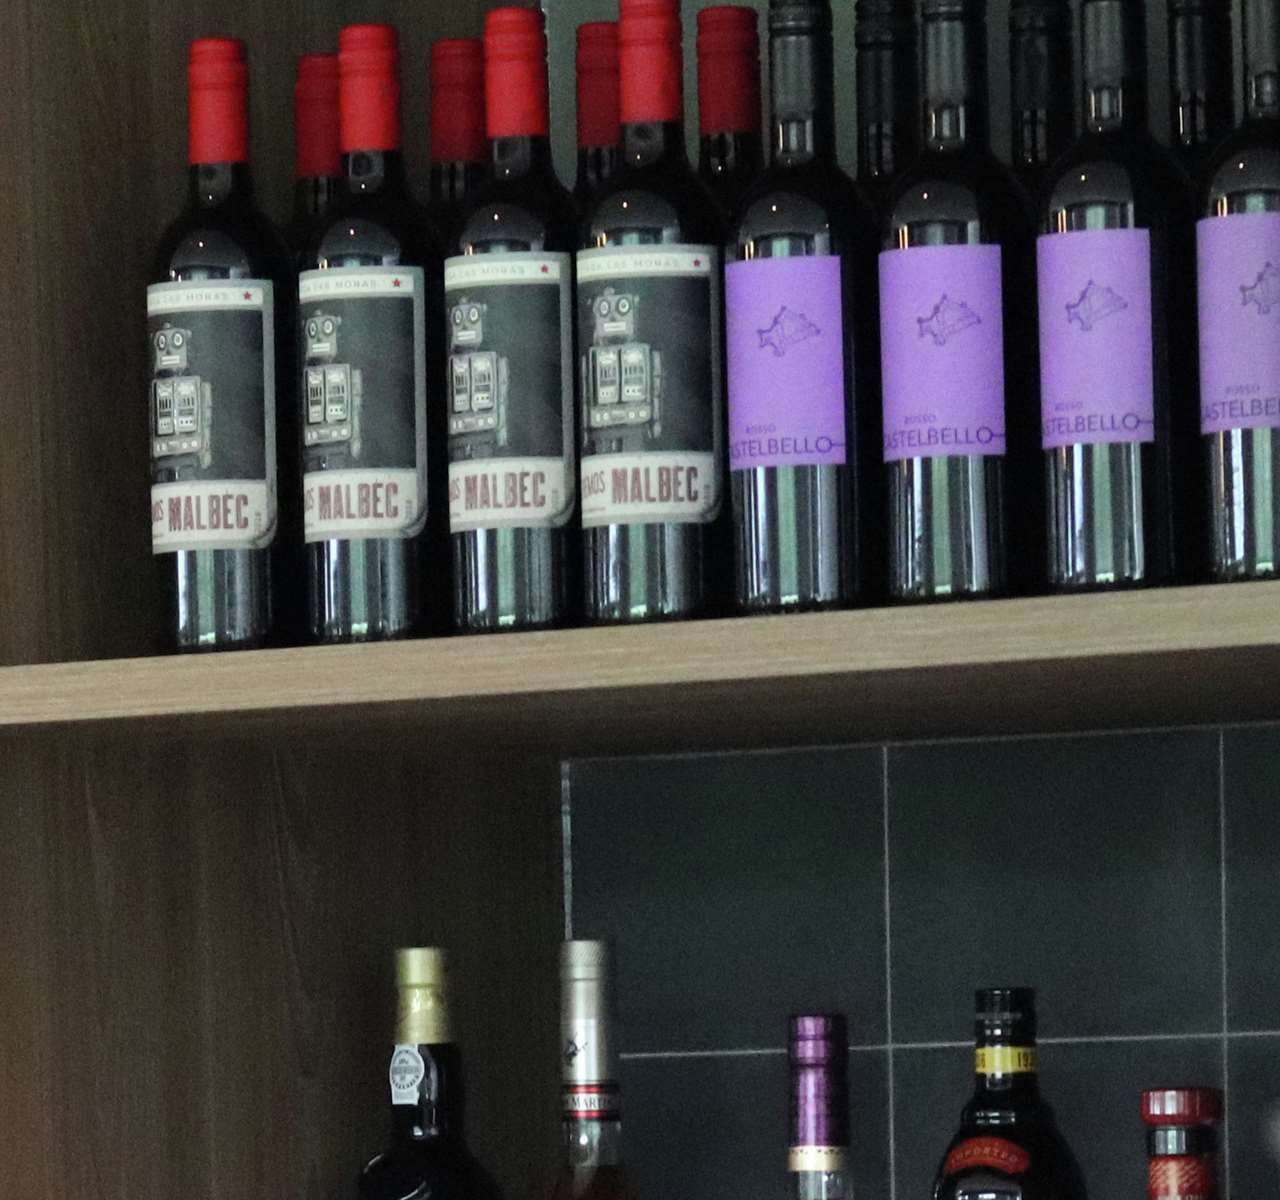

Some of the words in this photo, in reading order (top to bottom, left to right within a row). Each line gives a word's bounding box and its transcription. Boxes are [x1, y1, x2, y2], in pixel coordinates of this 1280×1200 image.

[730, 436, 833, 459] STELBELLO
[319, 482, 399, 520] MALBEC
[464, 471, 546, 510] MALBEC
[611, 465, 699, 504] MALBEC
[169, 493, 249, 533] MALBEC
